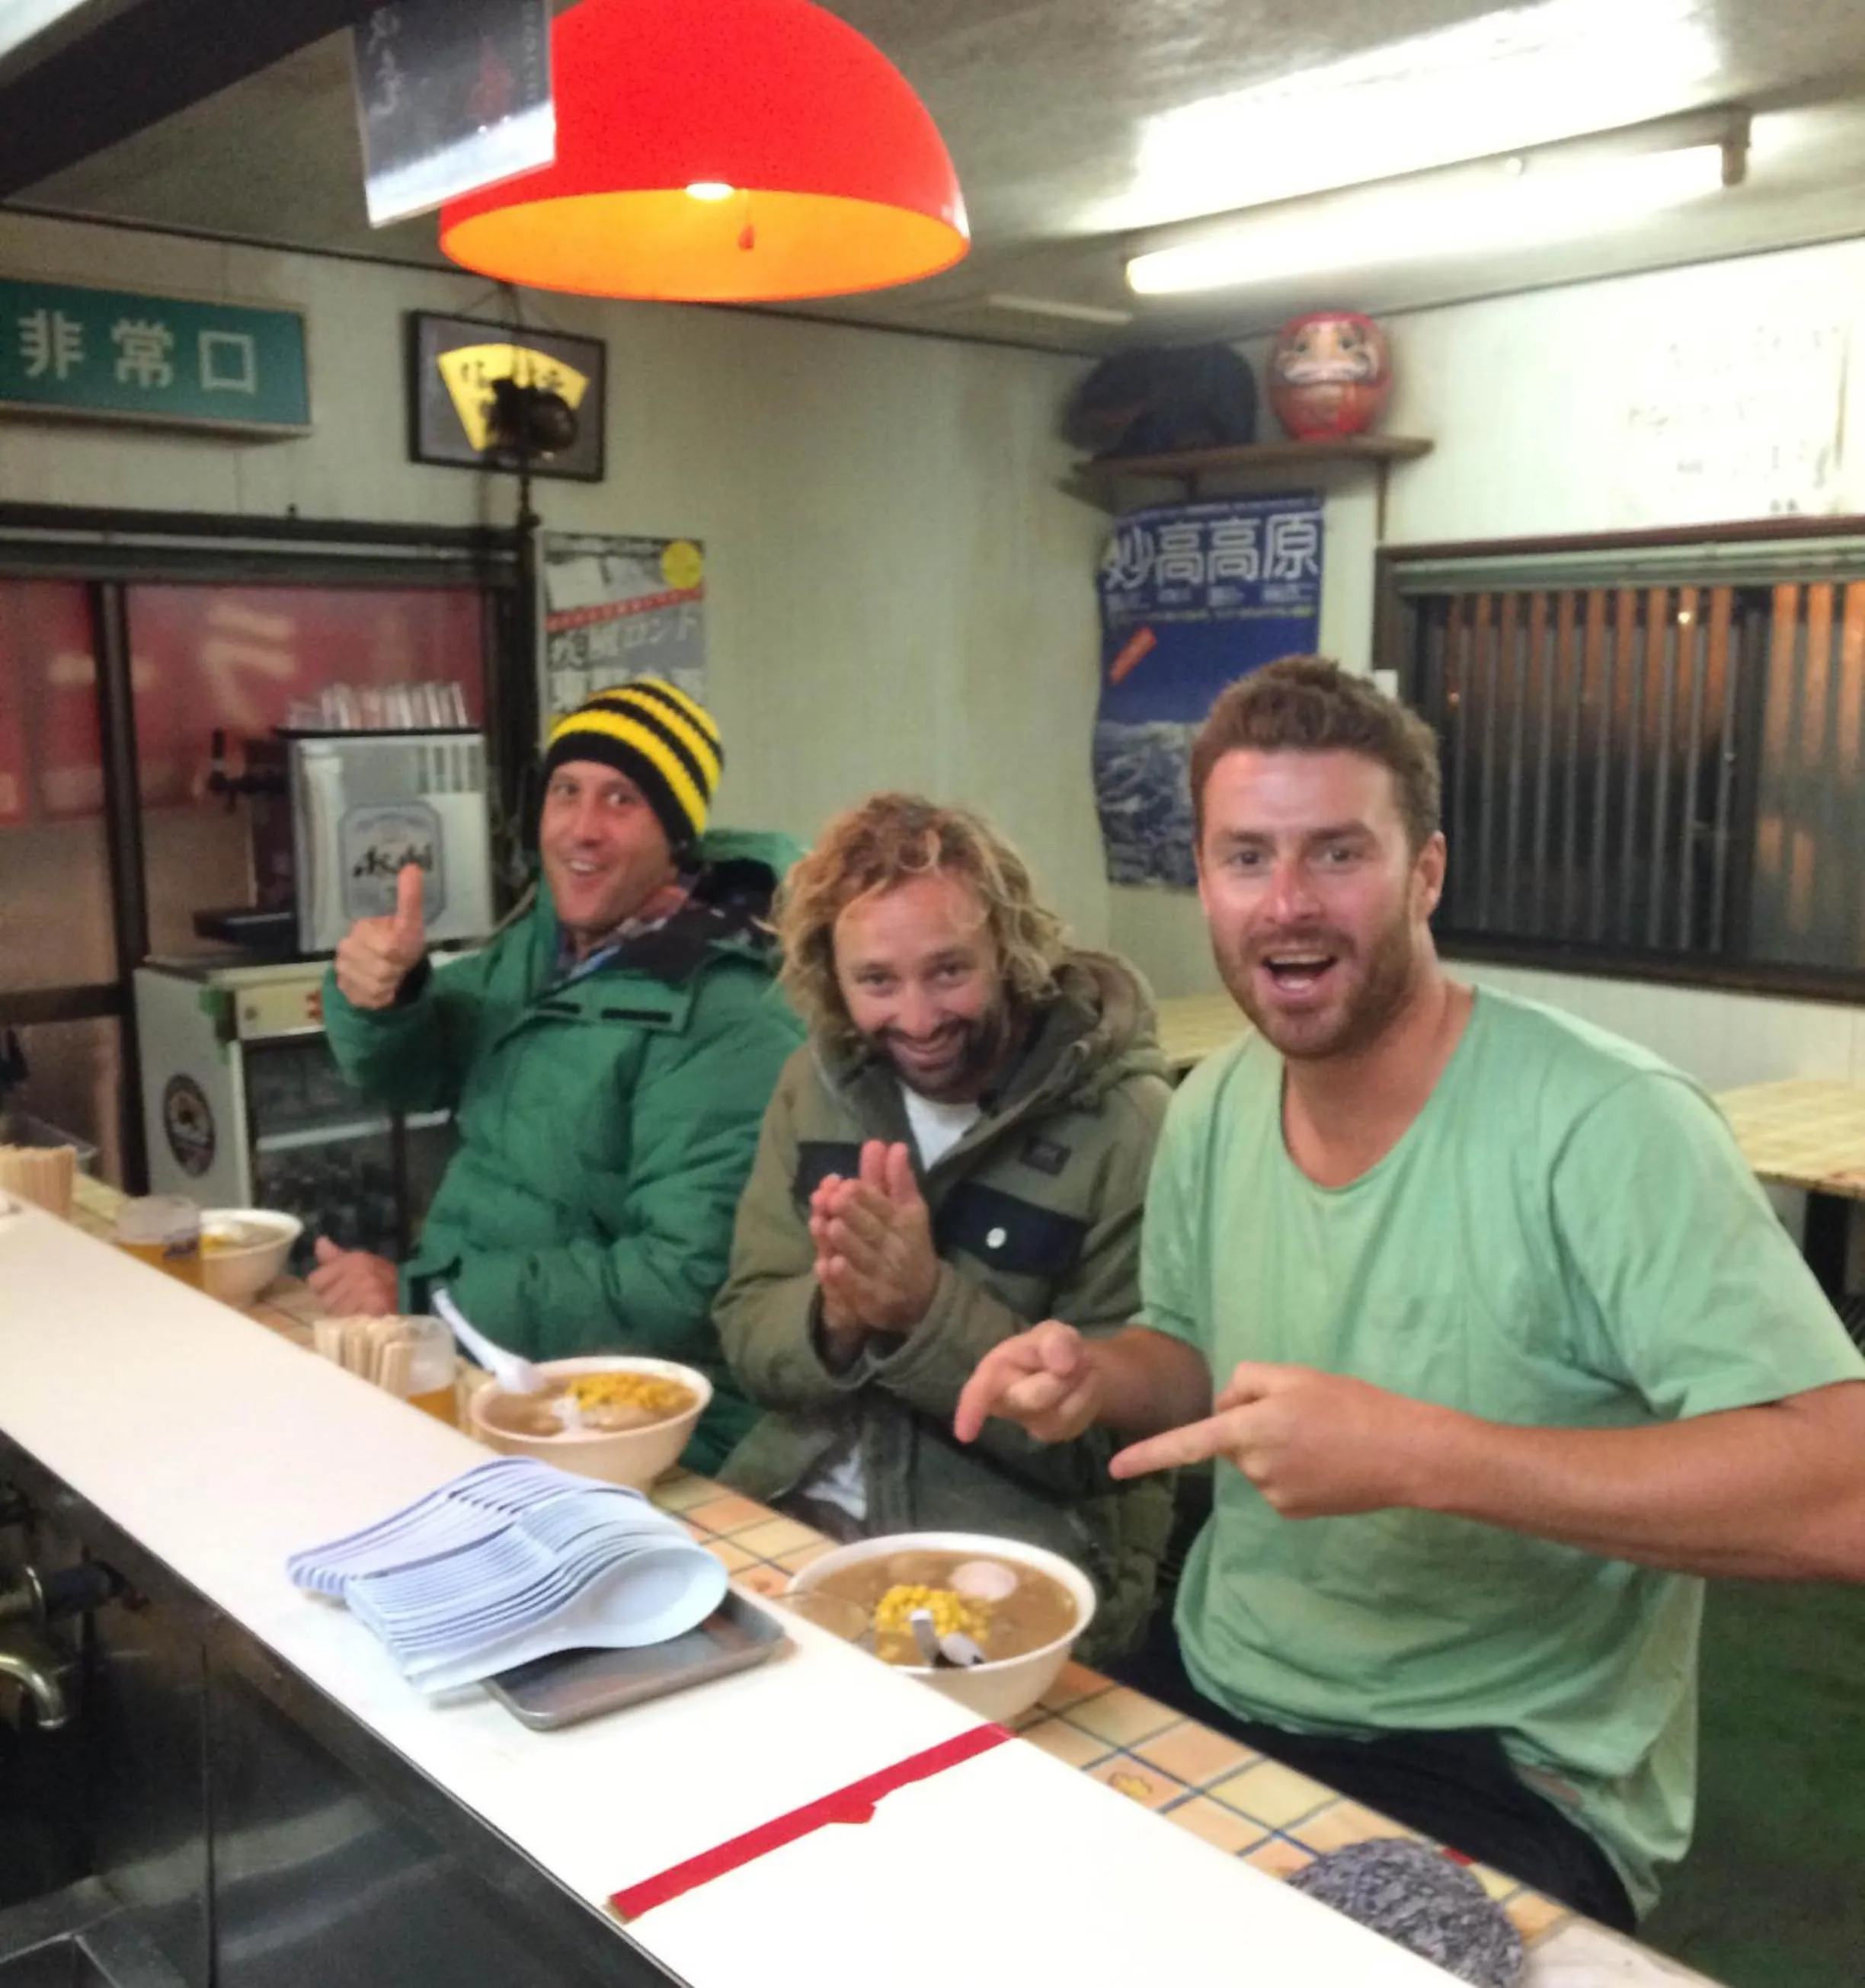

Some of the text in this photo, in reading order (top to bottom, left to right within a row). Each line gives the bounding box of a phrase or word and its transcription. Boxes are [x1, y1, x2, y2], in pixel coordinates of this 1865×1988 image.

[18, 308, 257, 395] 非常口
[1102, 510, 1324, 591] 妙高高原
